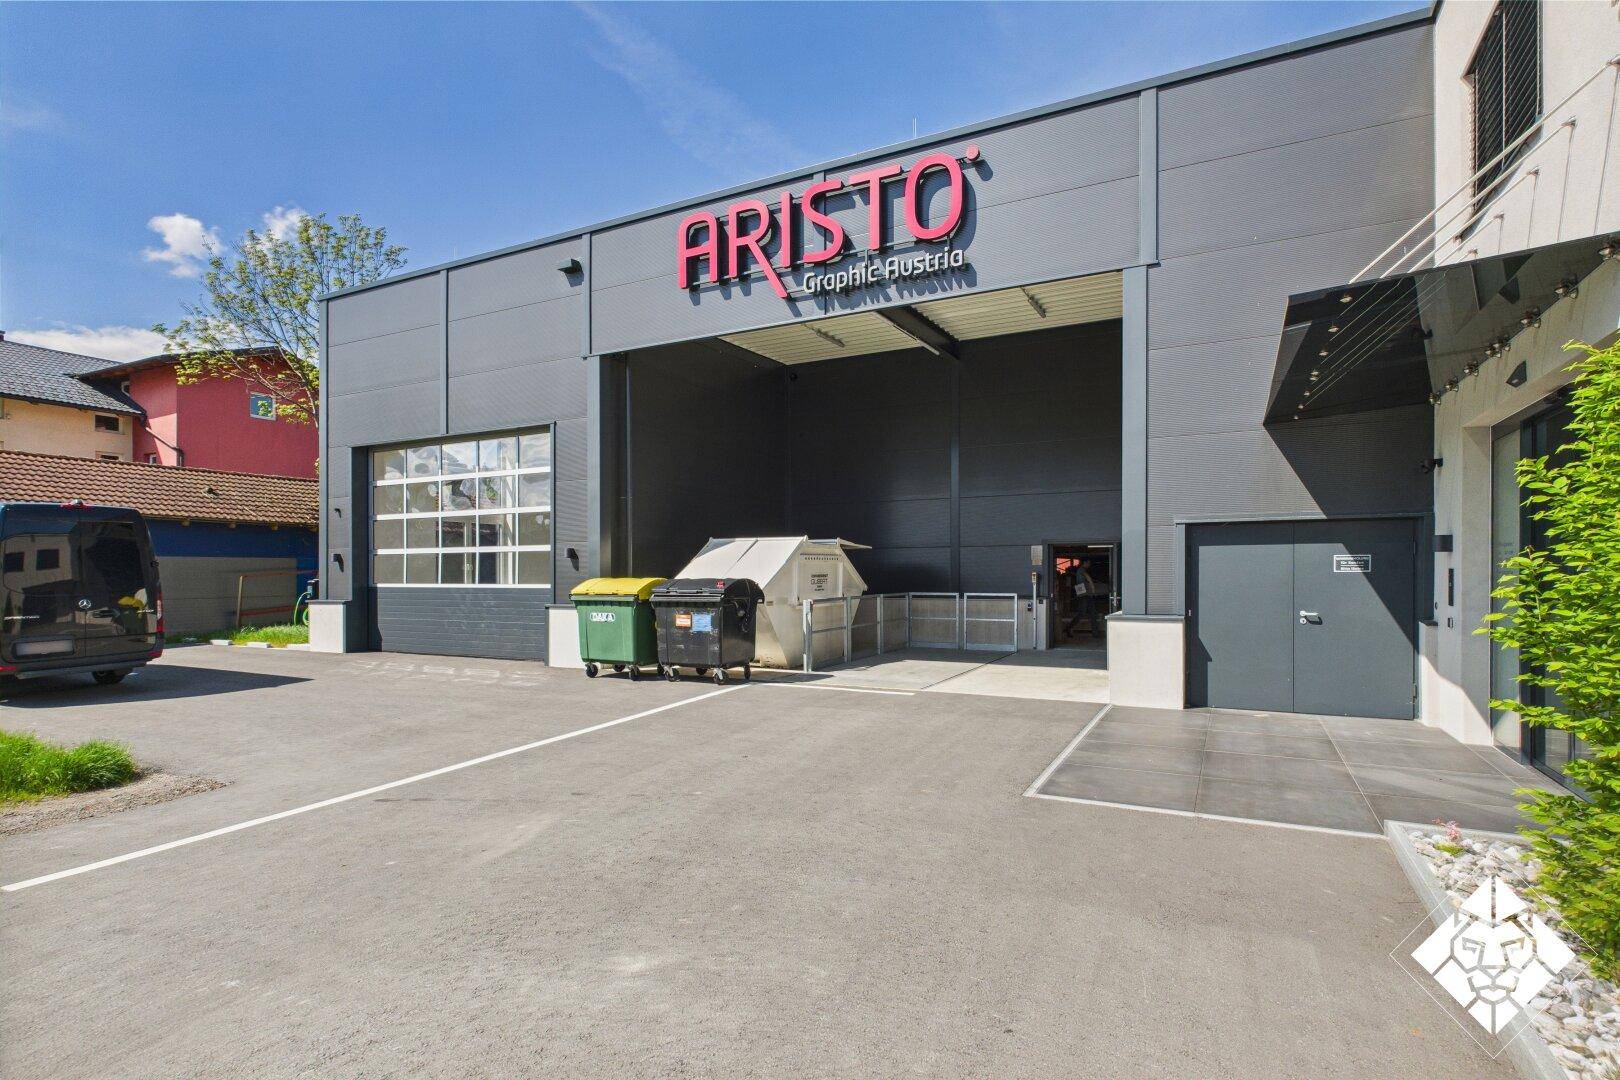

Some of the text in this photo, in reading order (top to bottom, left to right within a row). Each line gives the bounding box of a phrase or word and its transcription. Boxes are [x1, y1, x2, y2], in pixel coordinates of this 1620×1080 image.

[677, 152, 964, 299] ARISTO
[803, 247, 964, 293] Graphic Austria
